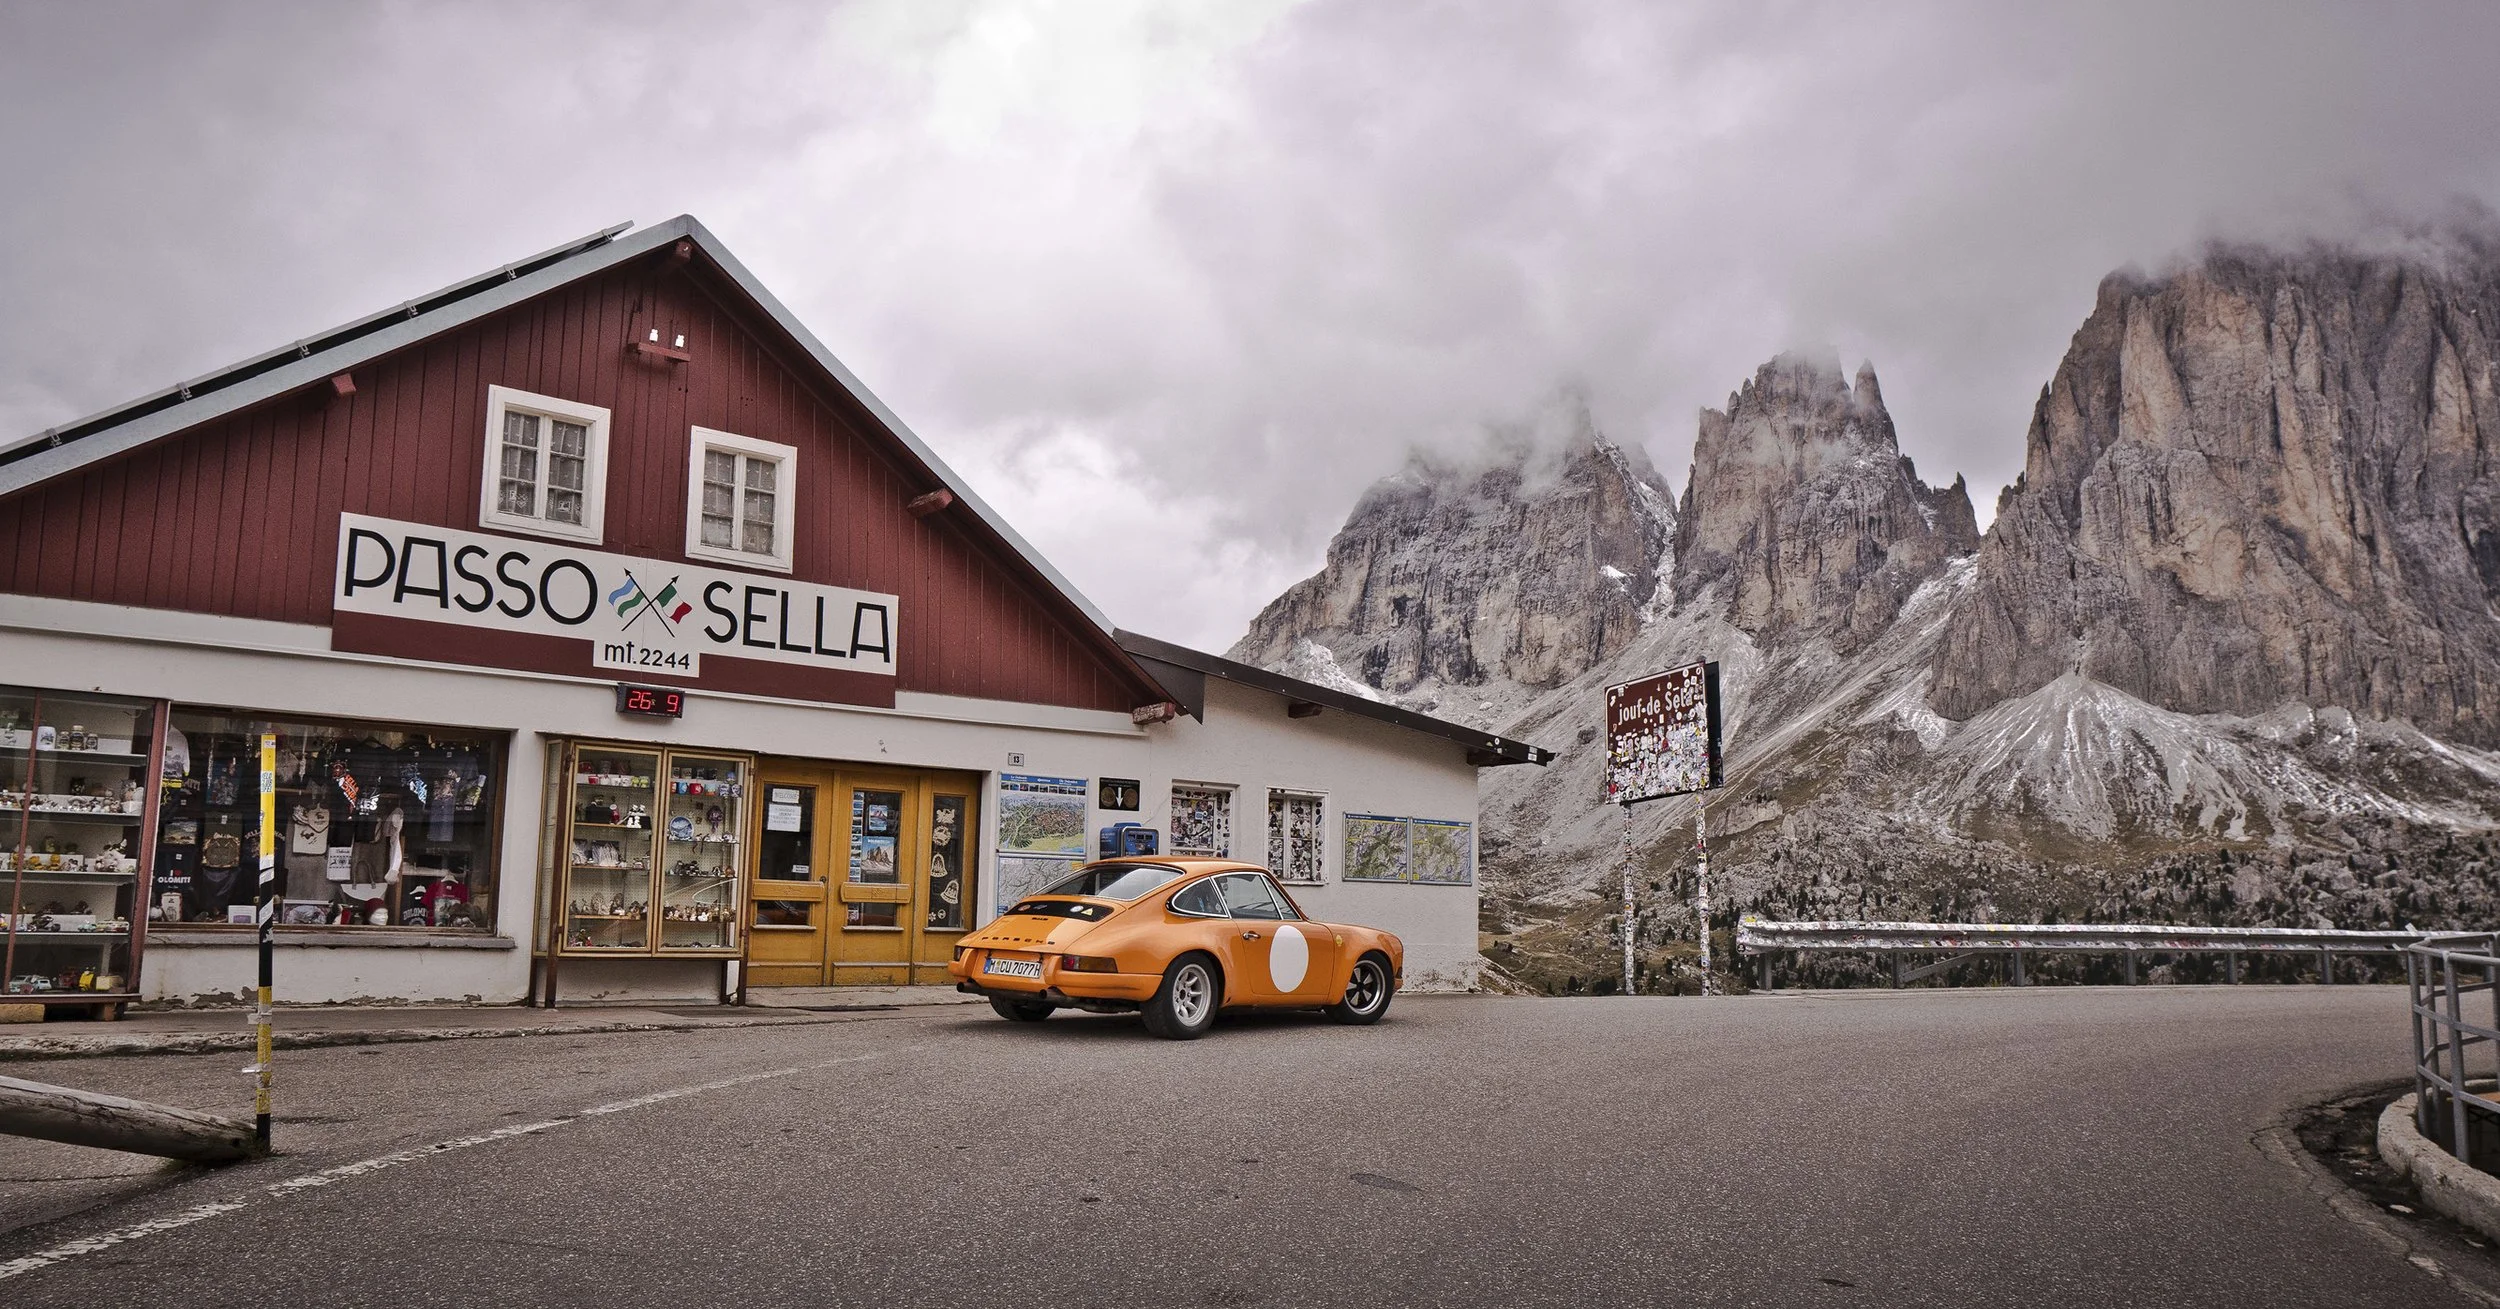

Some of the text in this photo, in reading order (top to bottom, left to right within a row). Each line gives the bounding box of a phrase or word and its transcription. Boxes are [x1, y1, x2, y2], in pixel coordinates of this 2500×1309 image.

[344, 527, 891, 664] PASSO SELLA
[628, 690, 679, 712] 26 9
[1646, 695, 1661, 716] de
[1013, 755, 1020, 763] 13
